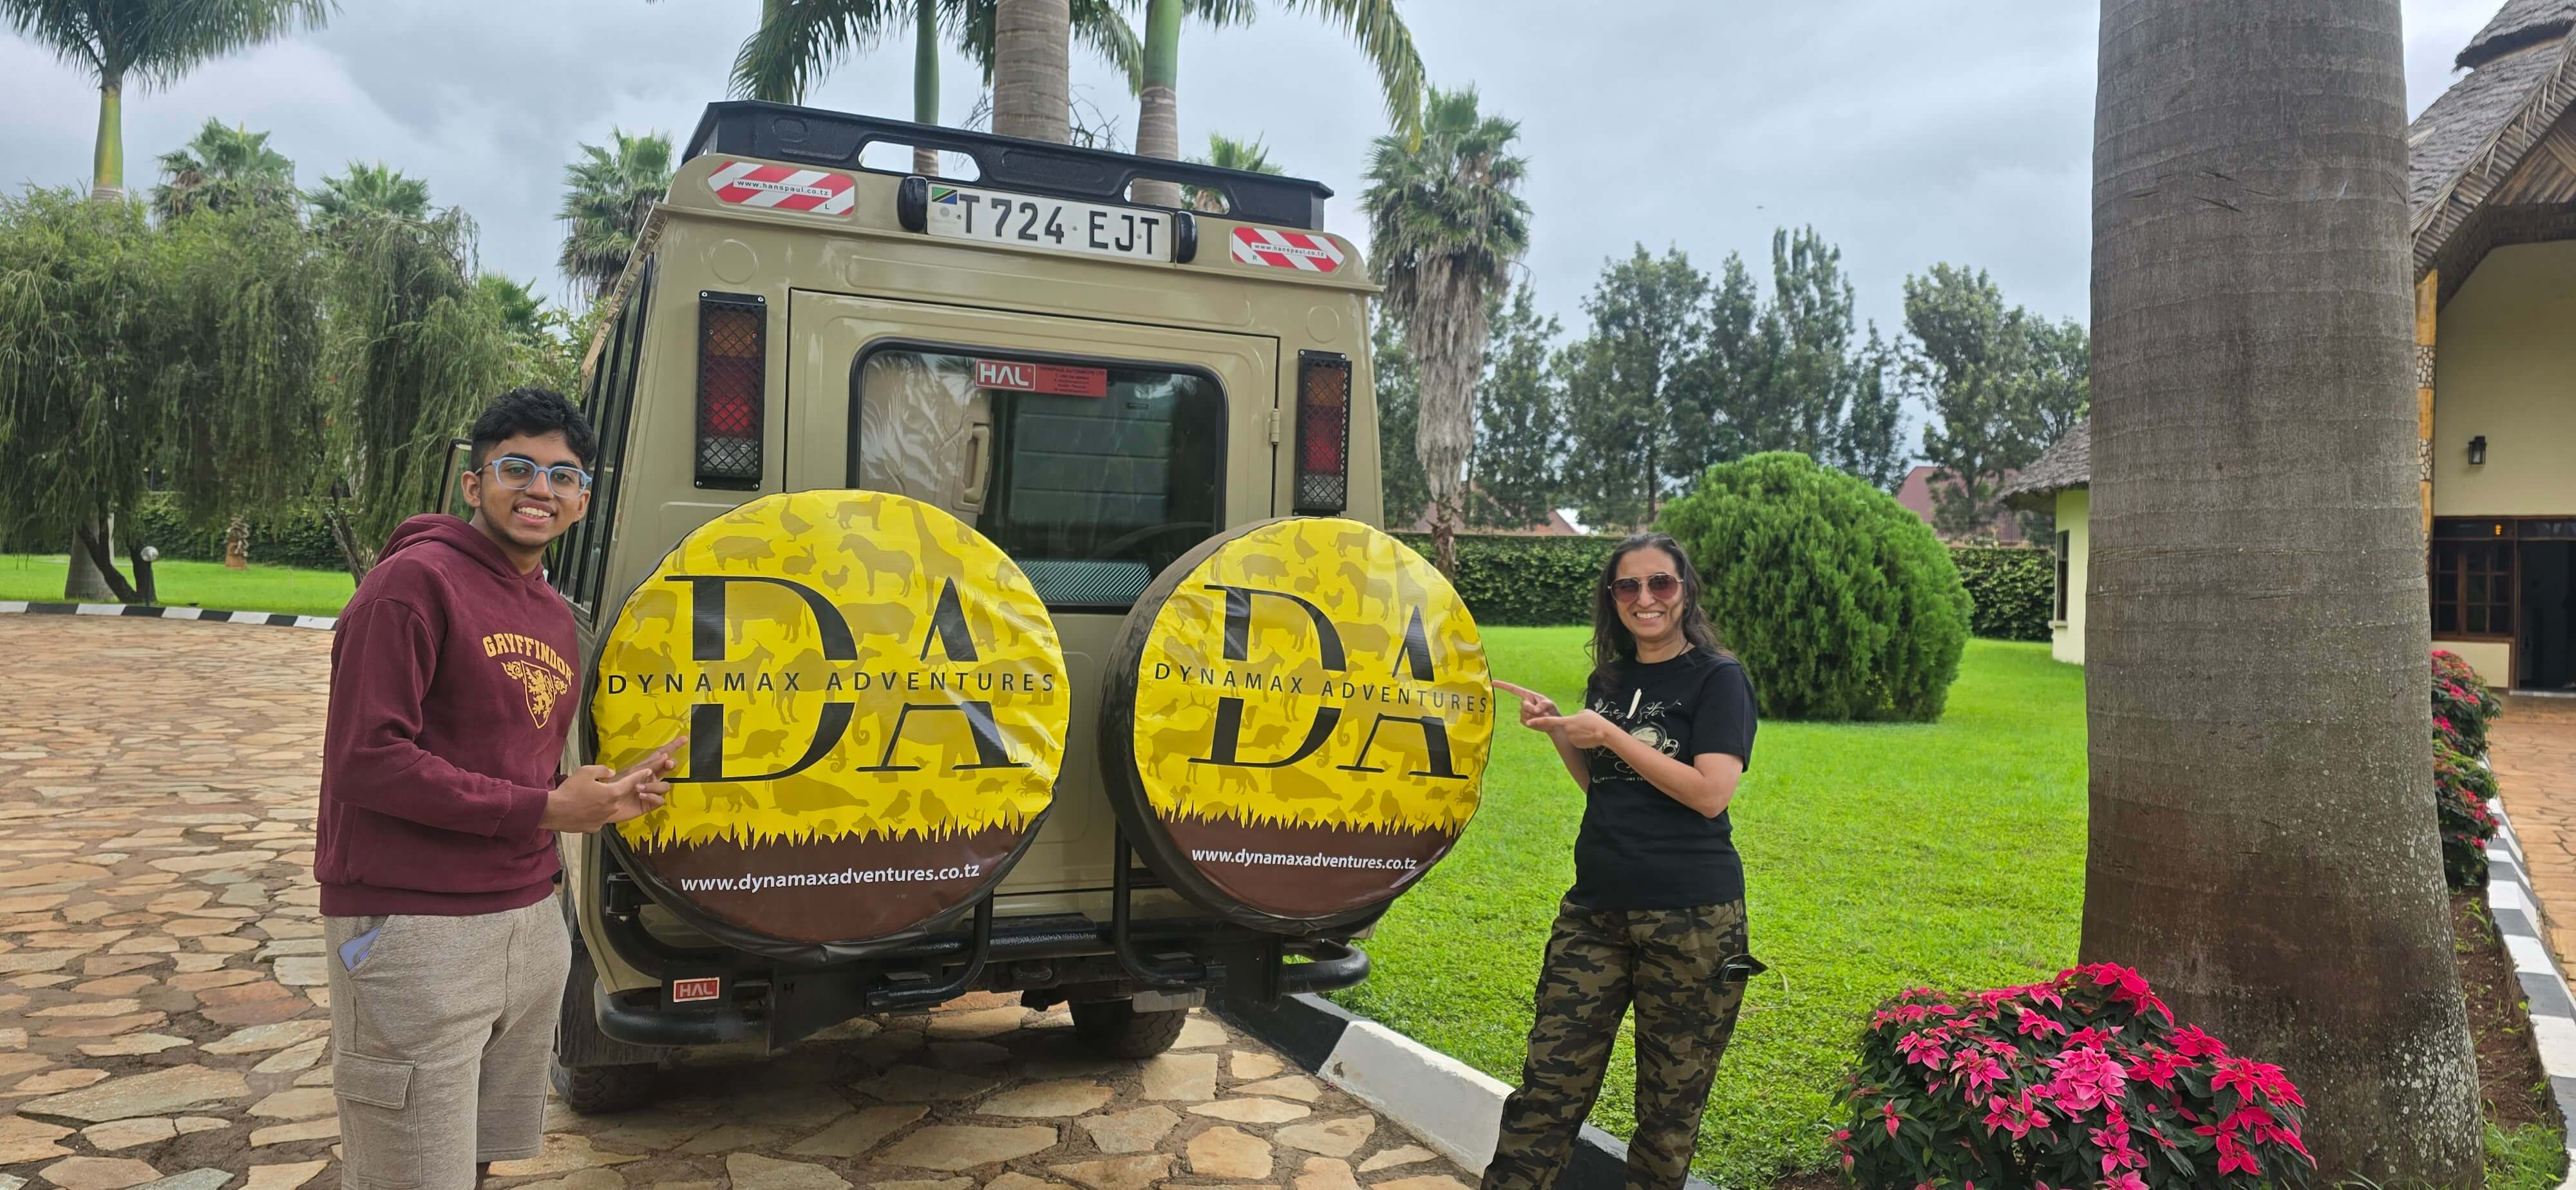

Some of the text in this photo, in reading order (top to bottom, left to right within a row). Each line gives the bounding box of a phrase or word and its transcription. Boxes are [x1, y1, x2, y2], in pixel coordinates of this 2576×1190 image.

[737, 180, 829, 196] www.hanspaul.co.tz
[959, 193, 1160, 255] T 724 EJT
[1254, 243, 1325, 257] www.hanspaul.co.tz
[980, 363, 1029, 387] HAL
[482, 633, 574, 686] GRYFFINDOR
[608, 672, 1055, 695] DYNAMAX ADVENTURES
[1155, 663, 1488, 713] DYNAMAX ADVENTURES
[1191, 847, 1417, 871] www.dynamaxadventures.co.tz
[680, 862, 981, 894] www.dynamaxadventures.co.tz
[679, 982, 714, 997] HAL
